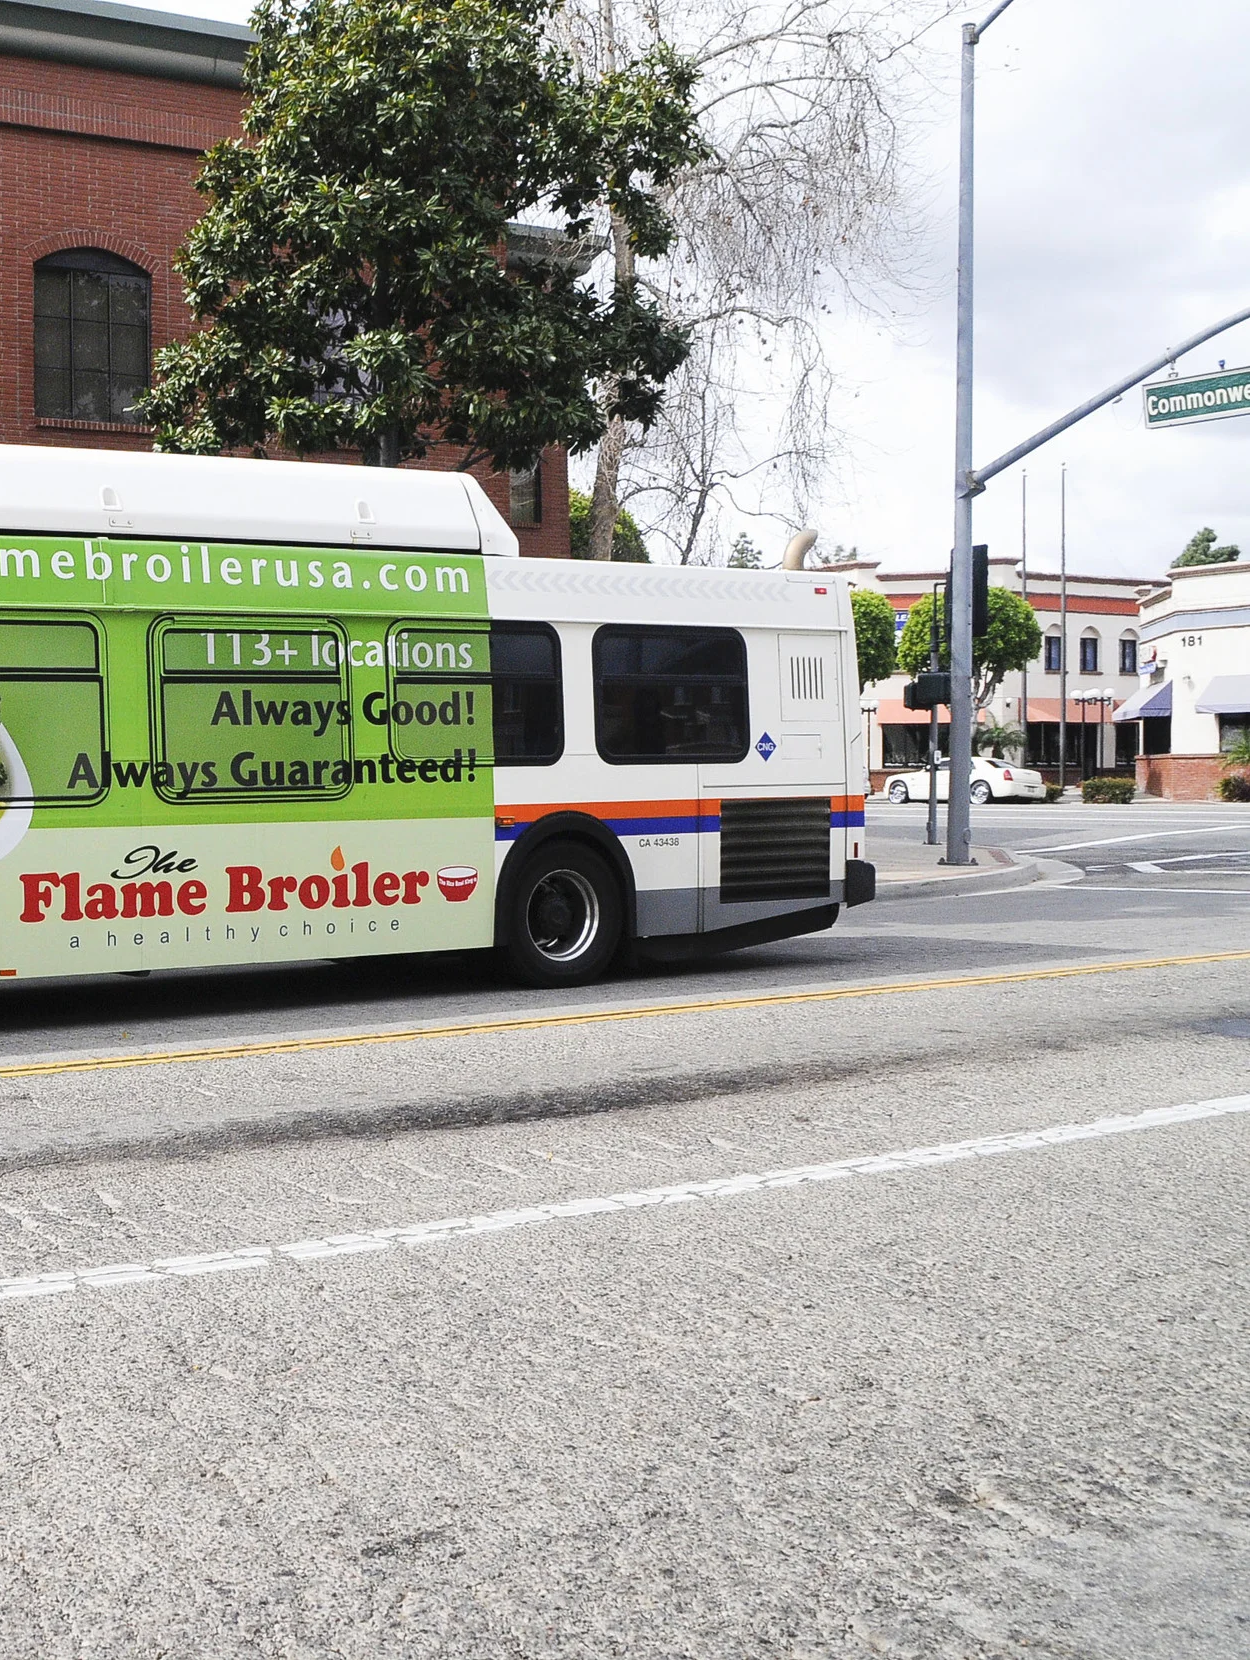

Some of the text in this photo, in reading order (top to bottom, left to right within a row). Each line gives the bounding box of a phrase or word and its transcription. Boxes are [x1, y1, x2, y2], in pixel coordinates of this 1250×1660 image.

[200, 629, 473, 669] 113+ locations
[1181, 635, 1203, 648] 181
[210, 689, 475, 737] Always Good!
[757, 742, 775, 751] CNG
[67, 748, 477, 800] Always Guaranteed!
[639, 838, 651, 848] CA
[110, 845, 199, 880] The
[19, 846, 429, 923] Flame Broiler
[69, 917, 401, 949] a healthy choice
